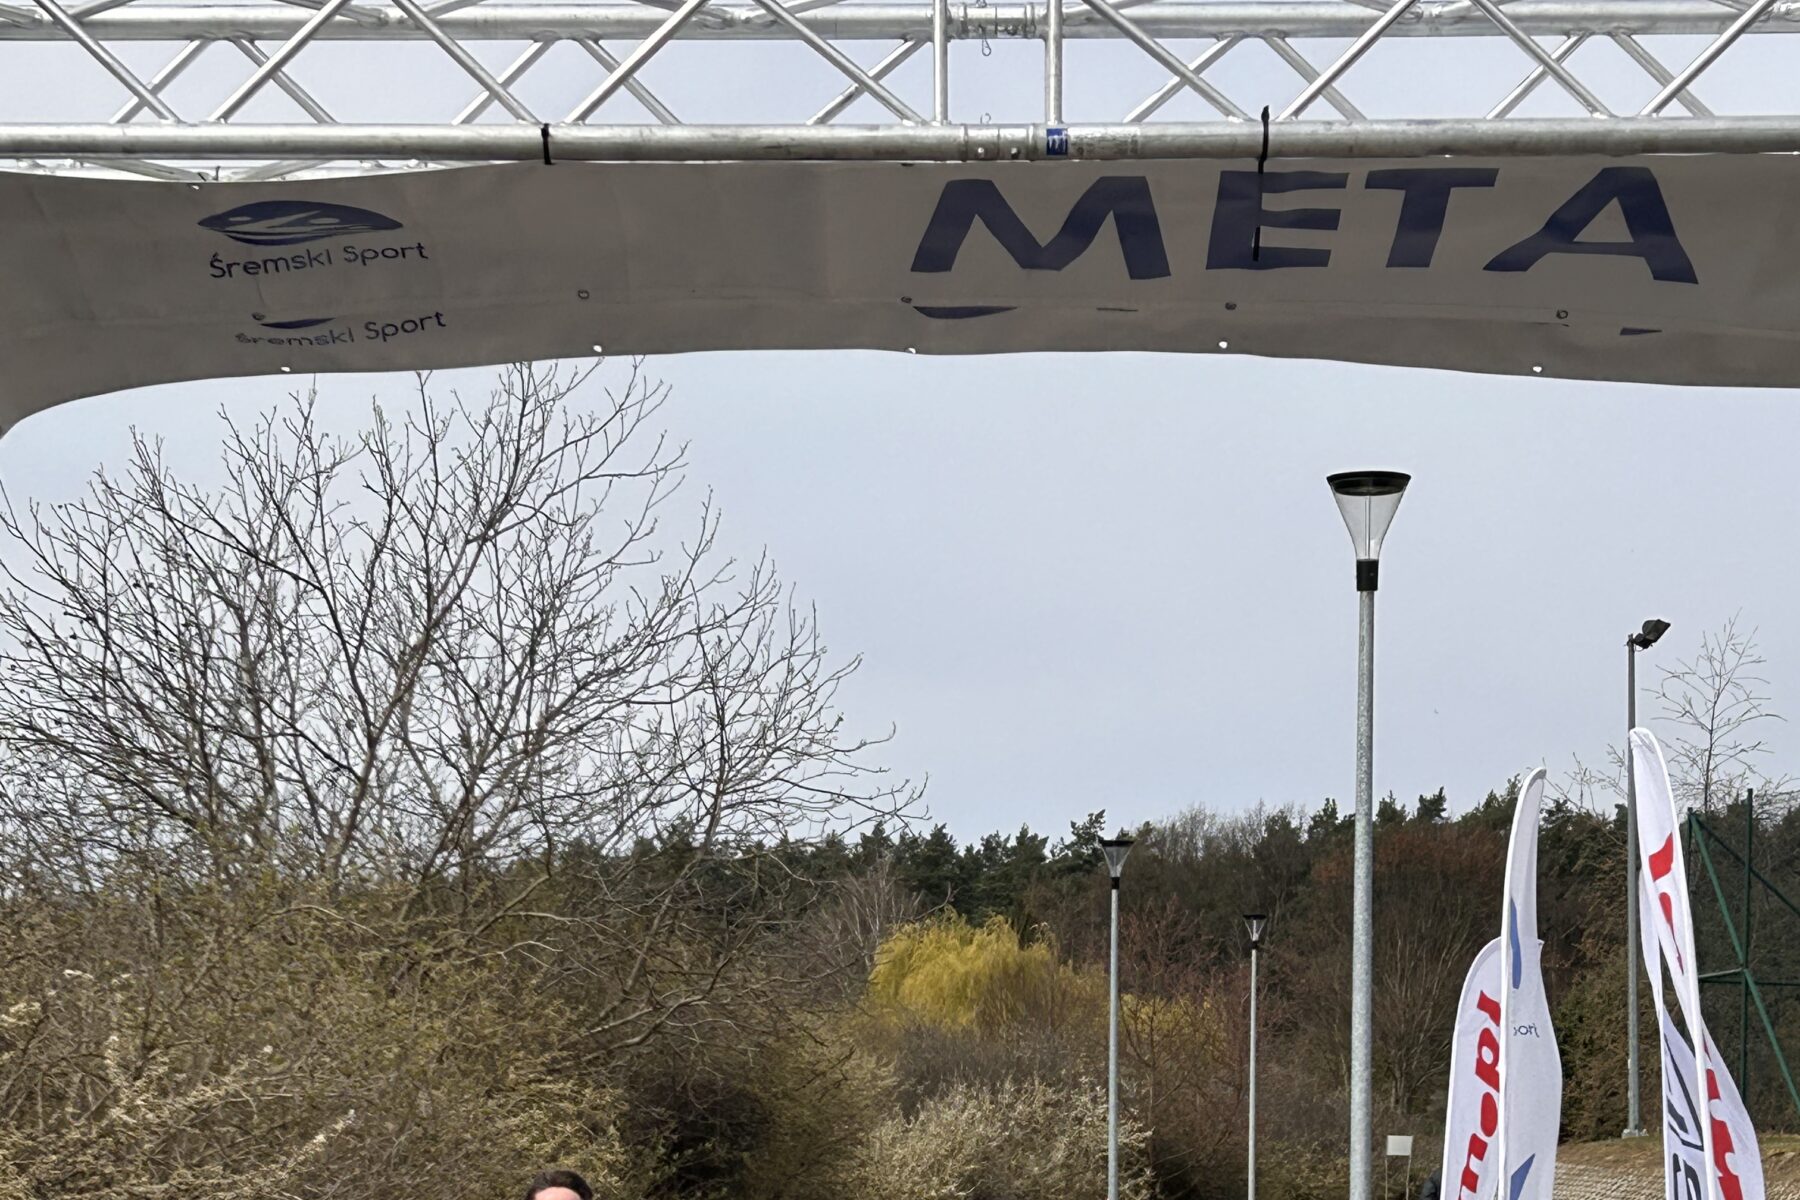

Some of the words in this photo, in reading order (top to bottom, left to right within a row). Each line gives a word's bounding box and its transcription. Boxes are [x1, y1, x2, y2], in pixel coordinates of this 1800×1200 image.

[910, 165, 1700, 285] META
[208, 248, 333, 279] Śremski
[342, 241, 430, 267] Sport
[363, 311, 448, 343] Sport
